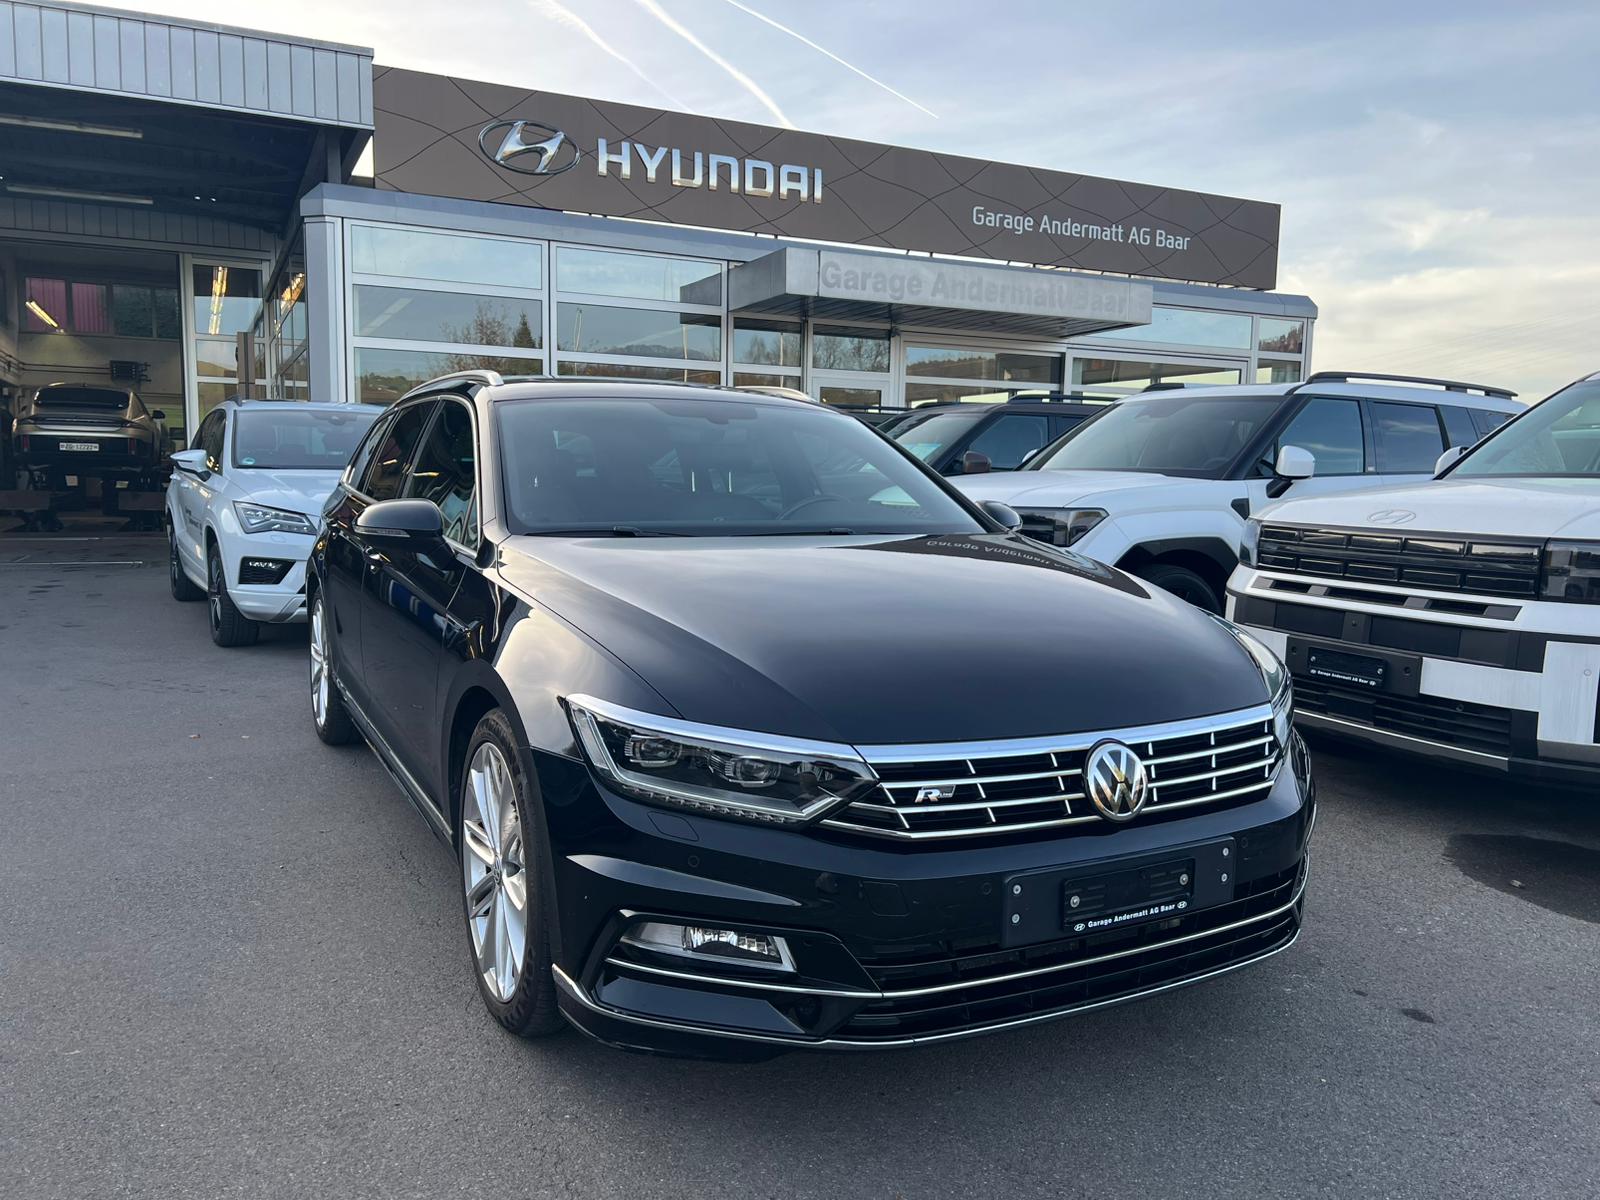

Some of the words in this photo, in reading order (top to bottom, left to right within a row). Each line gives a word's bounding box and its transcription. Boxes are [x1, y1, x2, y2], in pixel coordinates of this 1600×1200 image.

[597, 138, 823, 204] HYUNDAI
[972, 206, 1034, 234] Garage
[1039, 215, 1124, 242] Andermatt
[1128, 226, 1151, 246] AG
[1156, 230, 1191, 250] Baar
[820, 261, 923, 300] Garage
[931, 271, 1070, 310] Andermatt
[1088, 918, 1112, 928] Garage
[1114, 910, 1148, 922] Andermatt
[1149, 906, 1160, 915] AG
[1160, 904, 1175, 912] Baar
